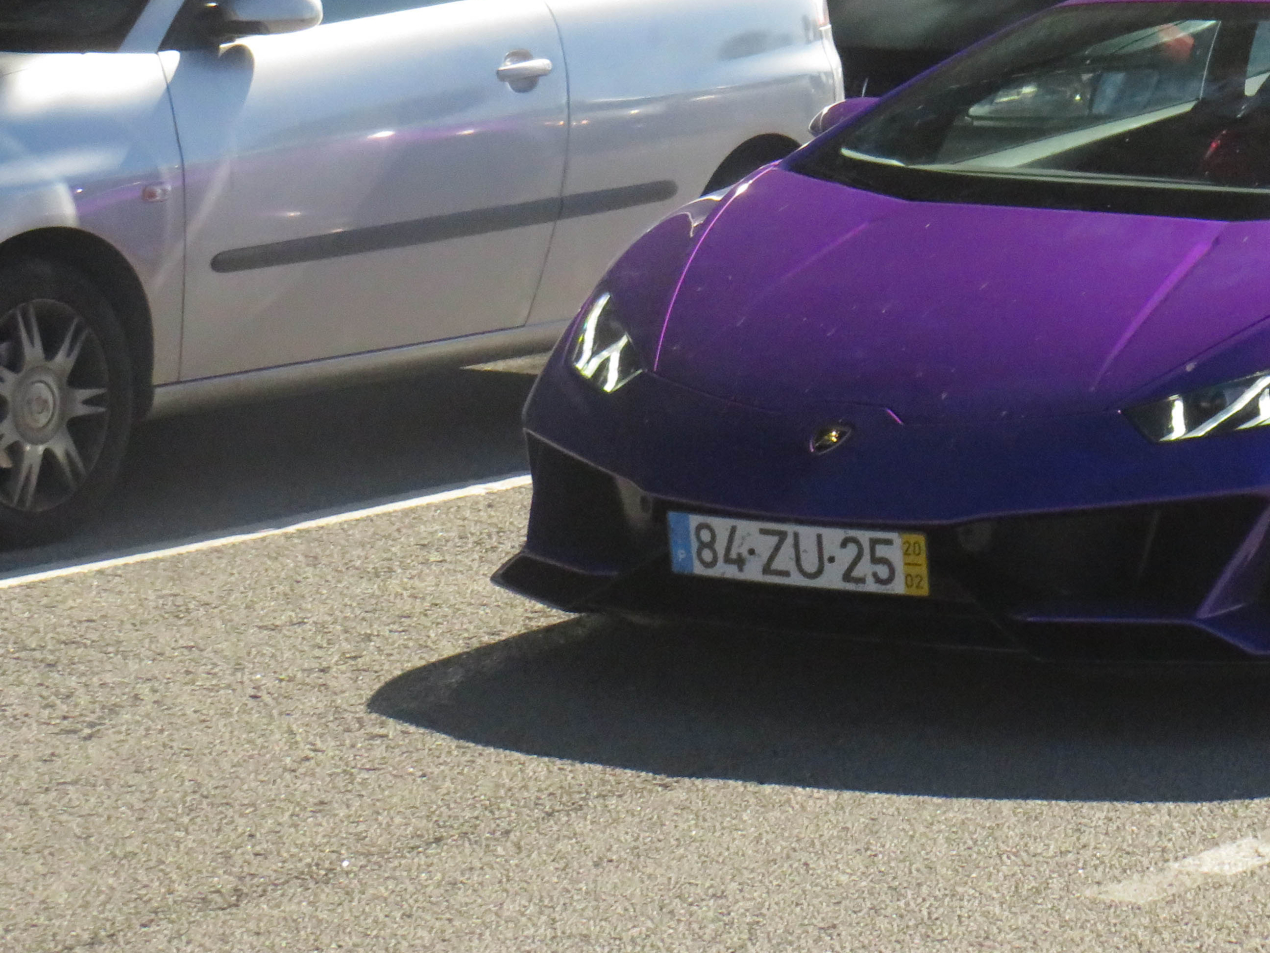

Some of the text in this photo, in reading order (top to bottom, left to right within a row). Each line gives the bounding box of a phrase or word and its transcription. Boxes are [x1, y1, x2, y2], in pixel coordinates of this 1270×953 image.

[677, 549, 687, 561] P
[903, 540, 922, 556] 20
[905, 573, 924, 590] 02
